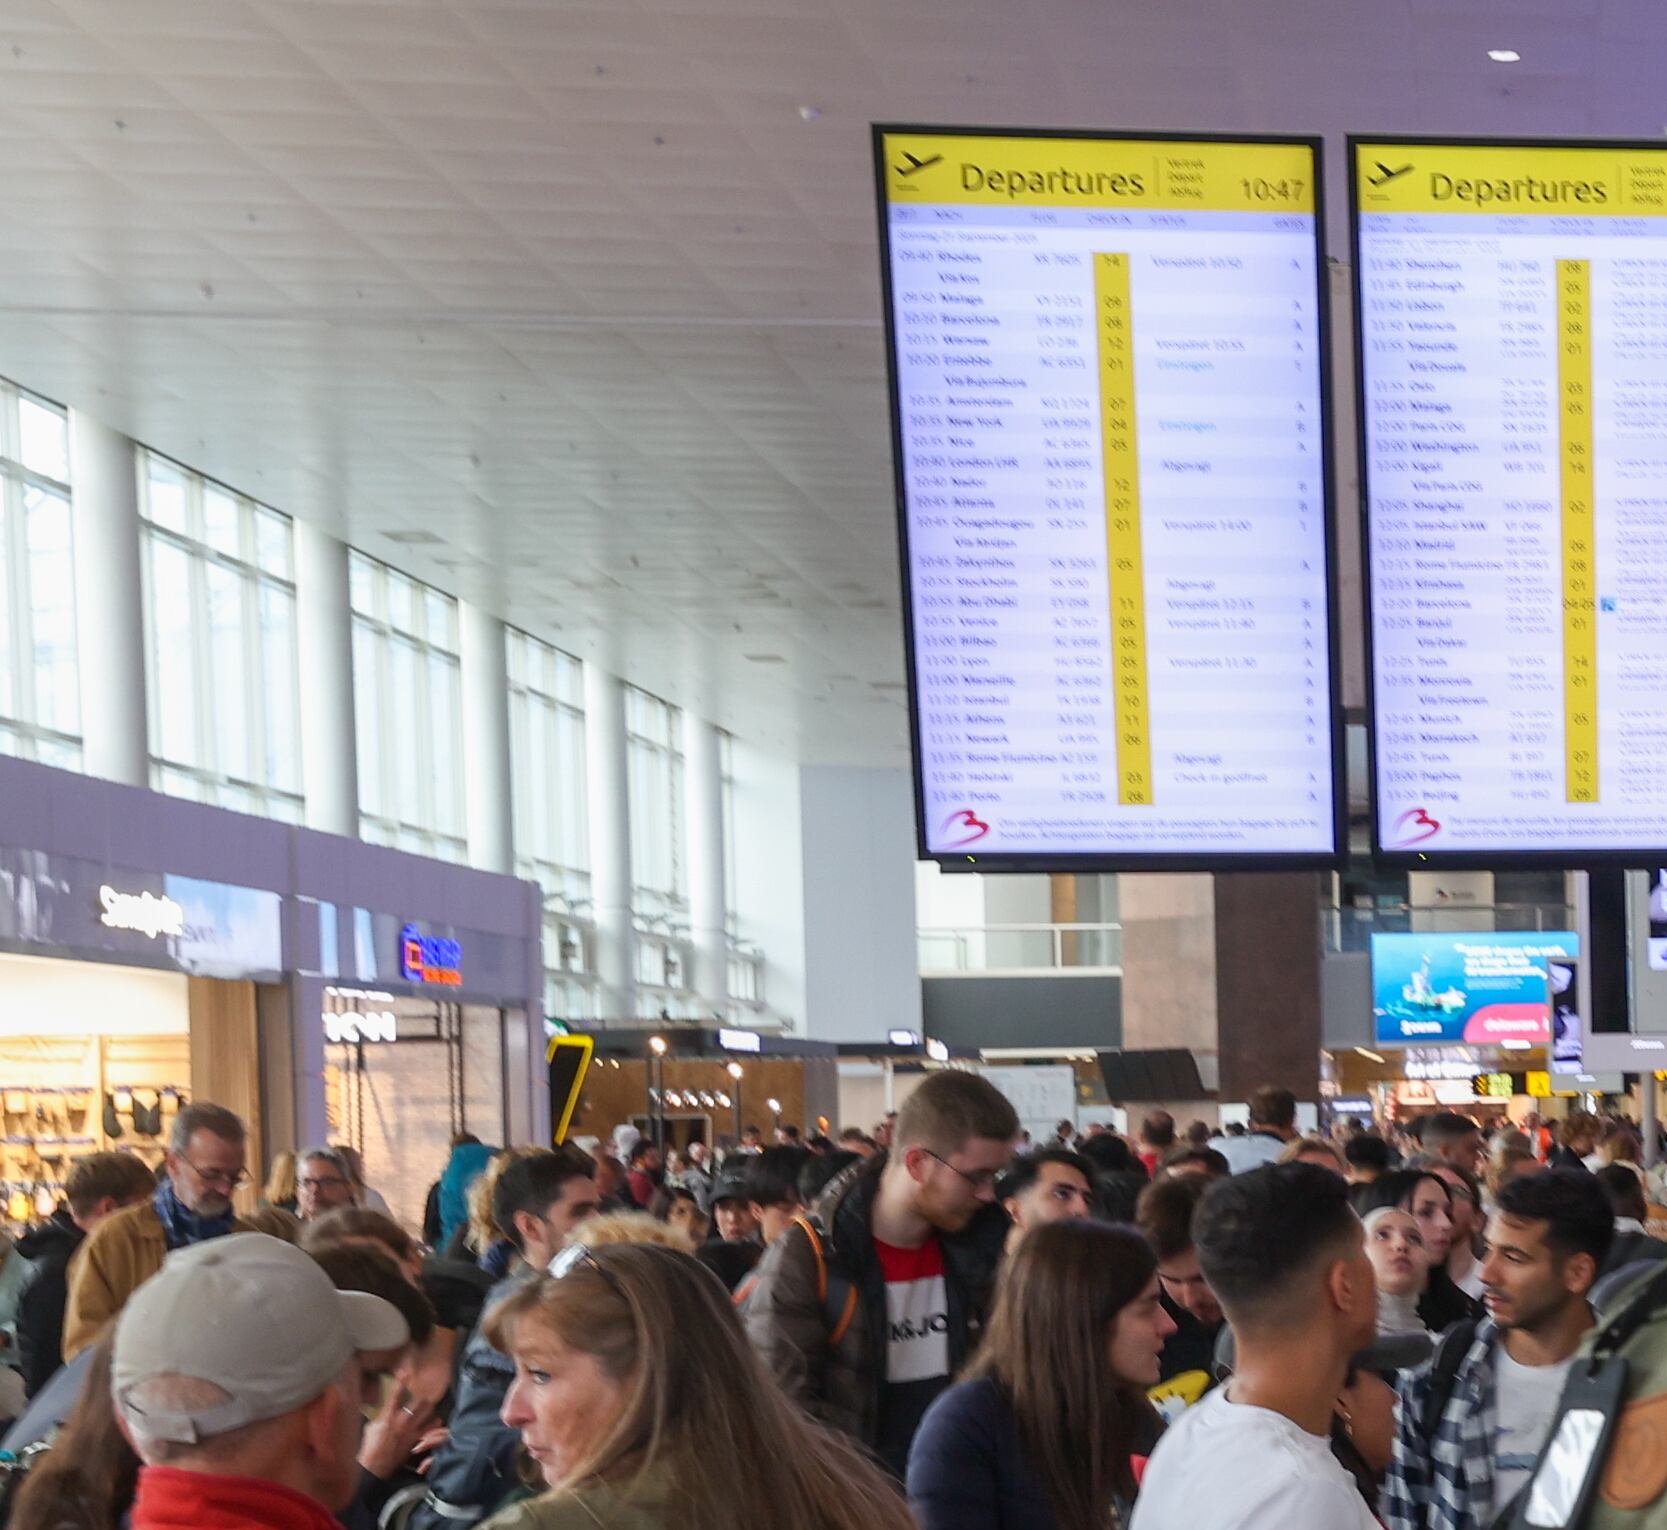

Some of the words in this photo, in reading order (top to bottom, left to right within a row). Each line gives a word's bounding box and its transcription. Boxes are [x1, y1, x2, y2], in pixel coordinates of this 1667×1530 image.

[961, 163, 1145, 199] Departures
[1240, 177, 1305, 201] 10:47
[1430, 172, 1607, 206] Departures
